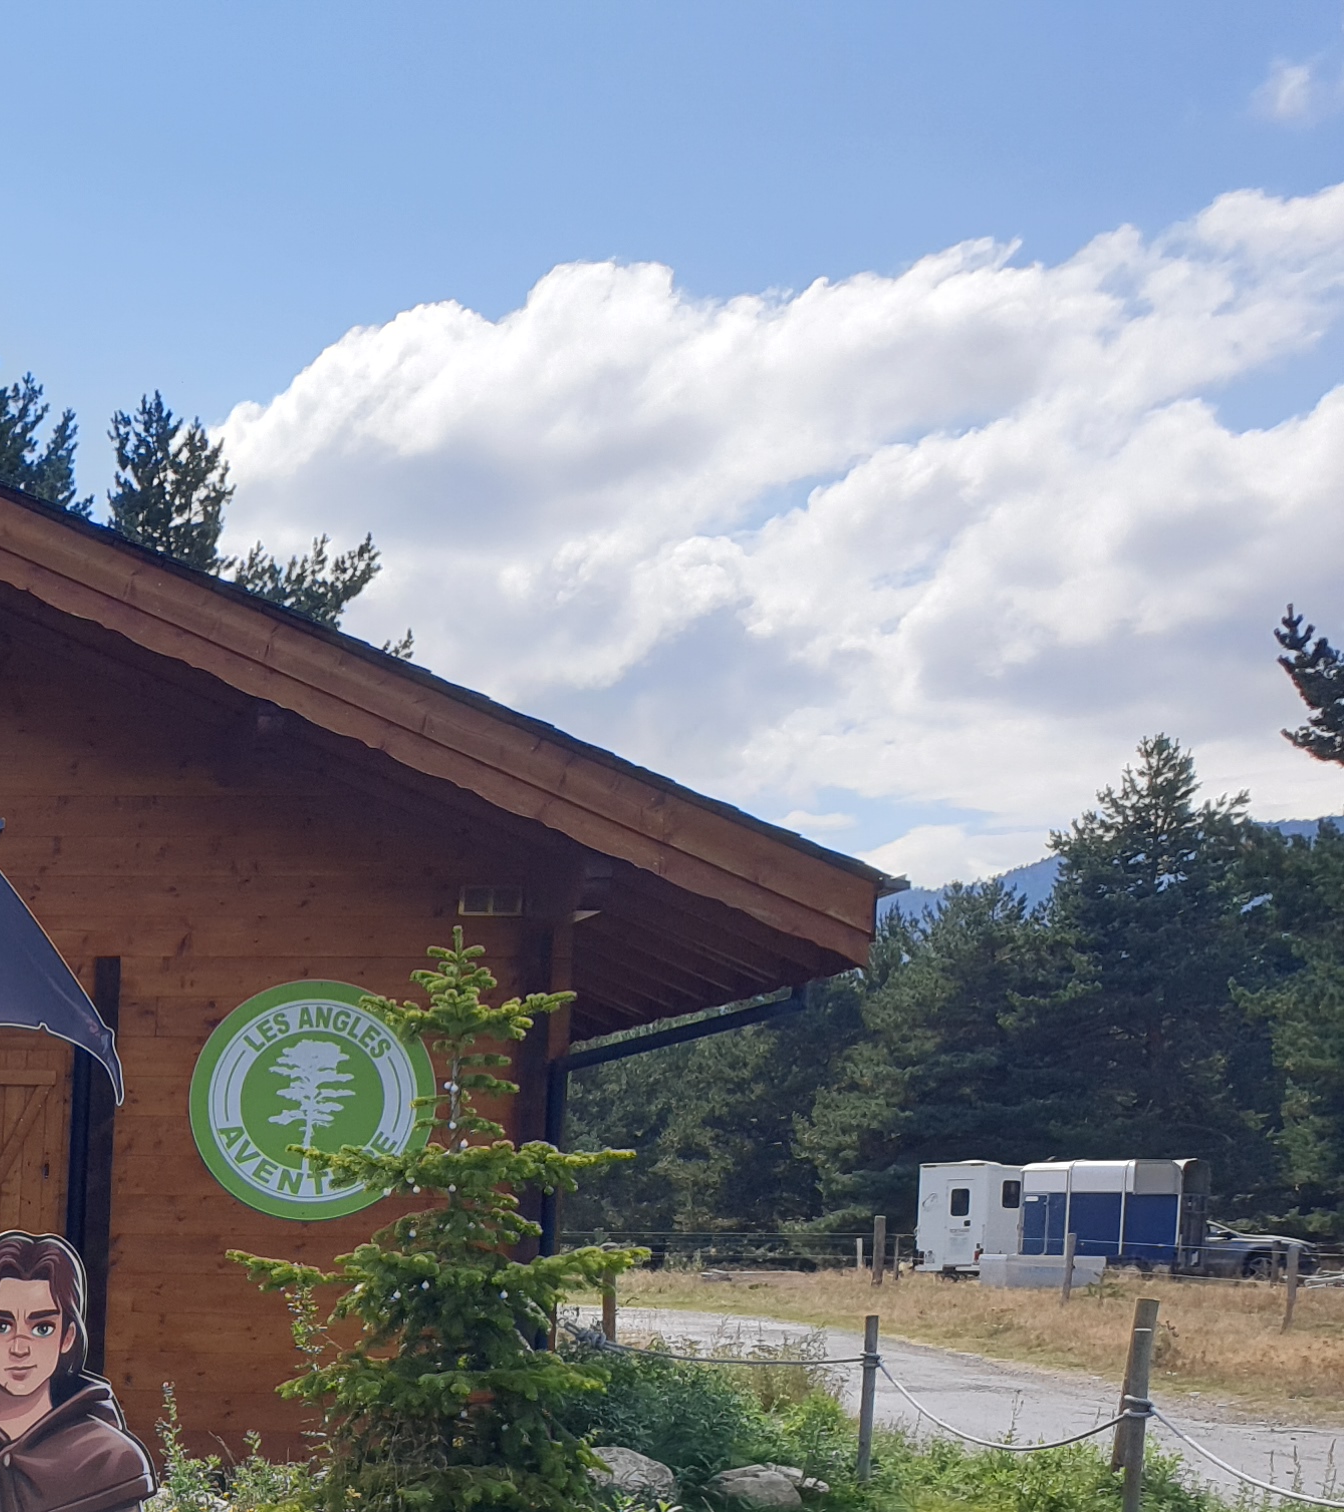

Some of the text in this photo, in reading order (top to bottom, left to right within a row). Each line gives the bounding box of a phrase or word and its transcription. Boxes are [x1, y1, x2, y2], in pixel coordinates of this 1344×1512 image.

[243, 1006, 392, 1059] LES ANGLES
[218, 1126, 398, 1195] AVENTE
